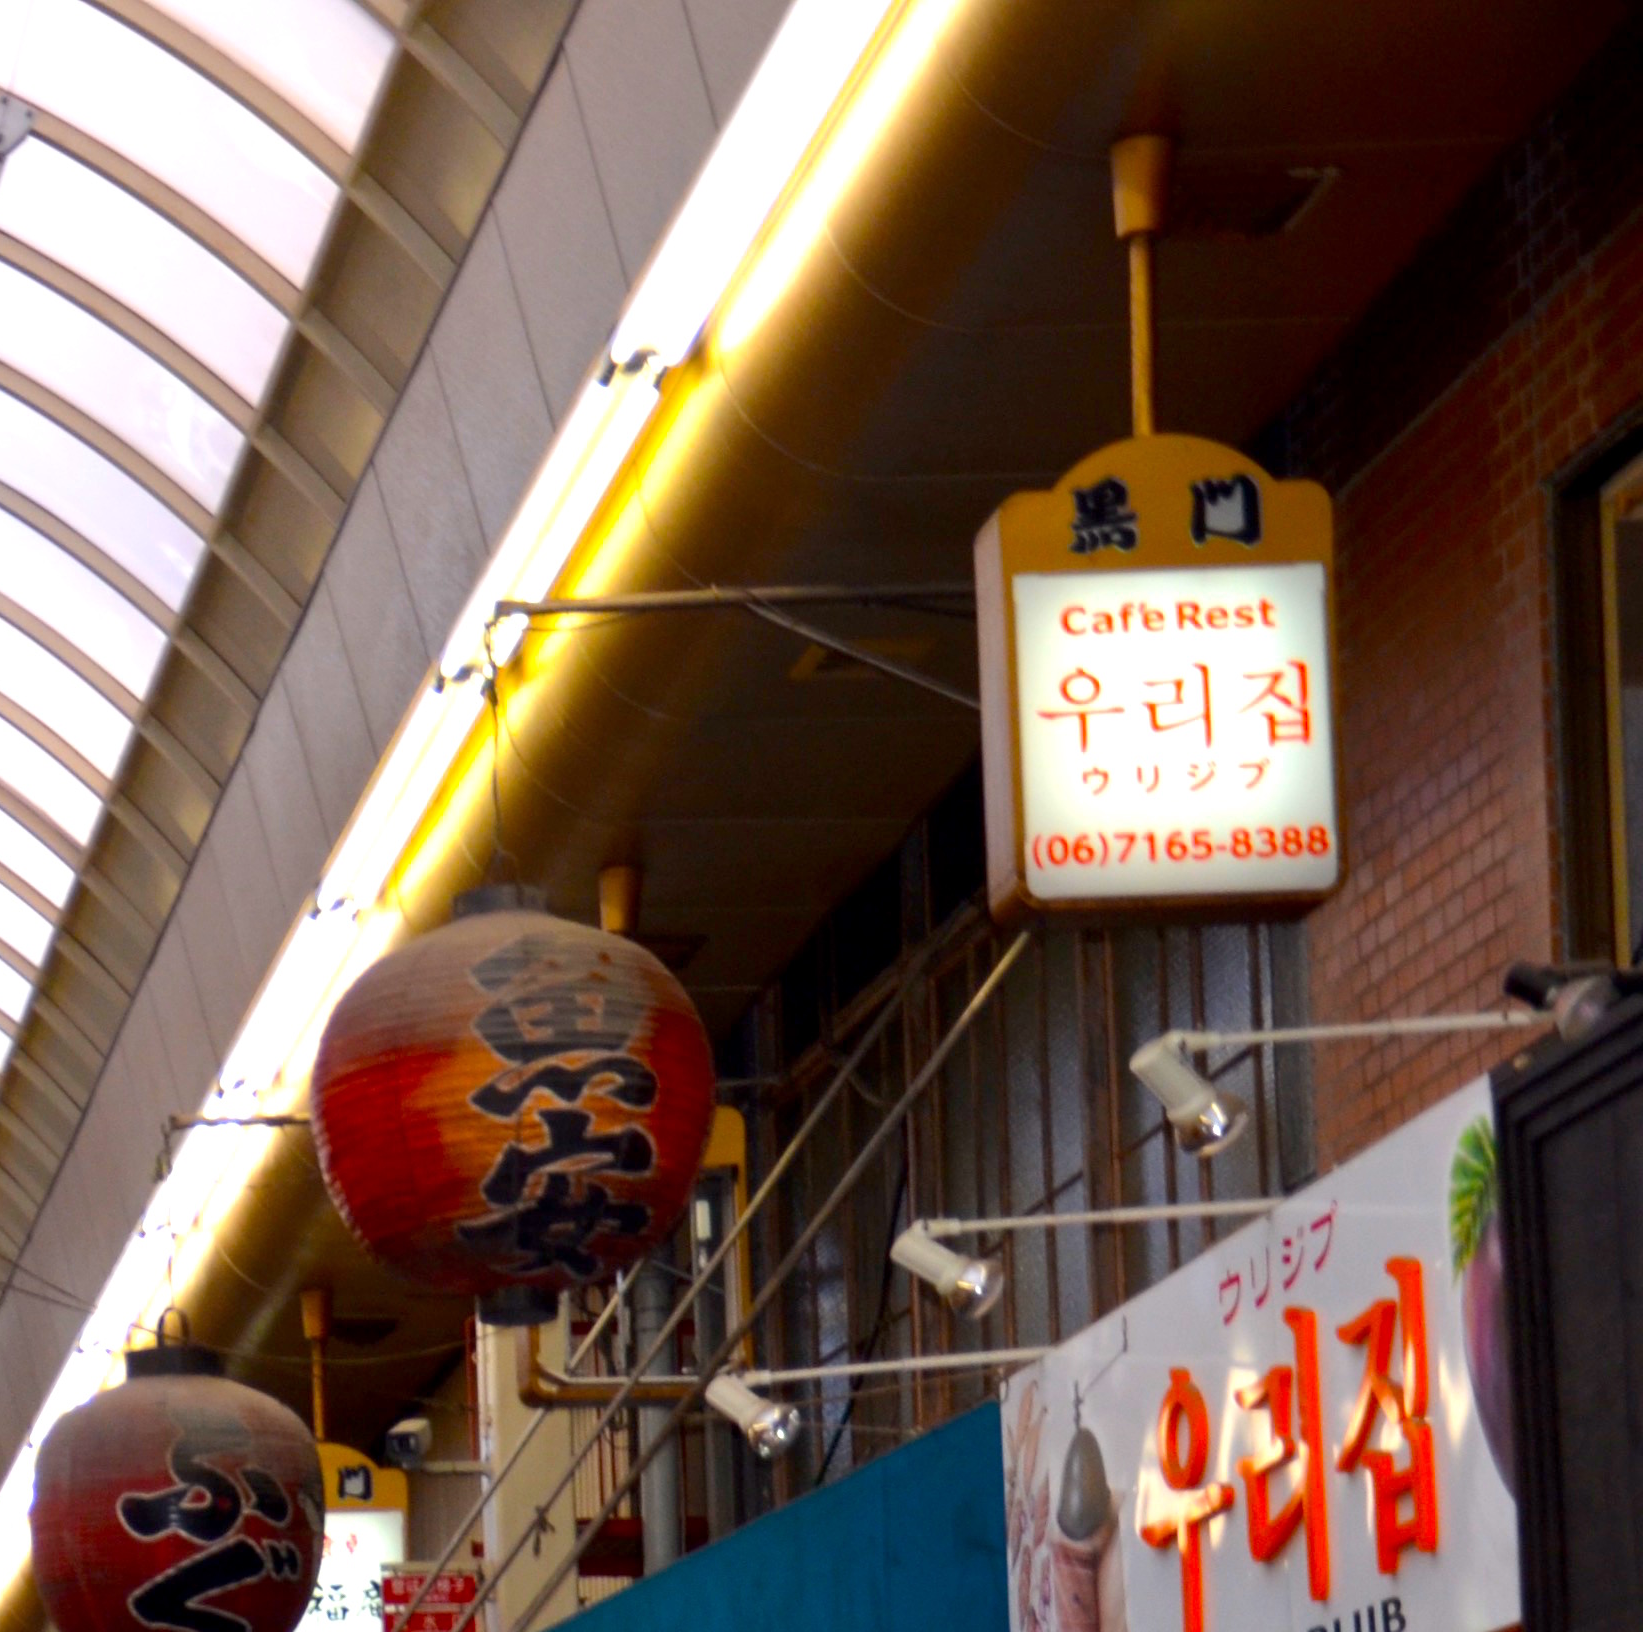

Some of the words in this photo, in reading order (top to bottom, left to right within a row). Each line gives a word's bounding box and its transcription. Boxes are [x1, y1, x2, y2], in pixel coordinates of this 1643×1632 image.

[1176, 598, 1277, 632] Rest
[1036, 658, 1313, 753] 우리집
[1031, 824, 1330, 870] (06)7165-8388
[1218, 1199, 1339, 1325] ウリジプ
